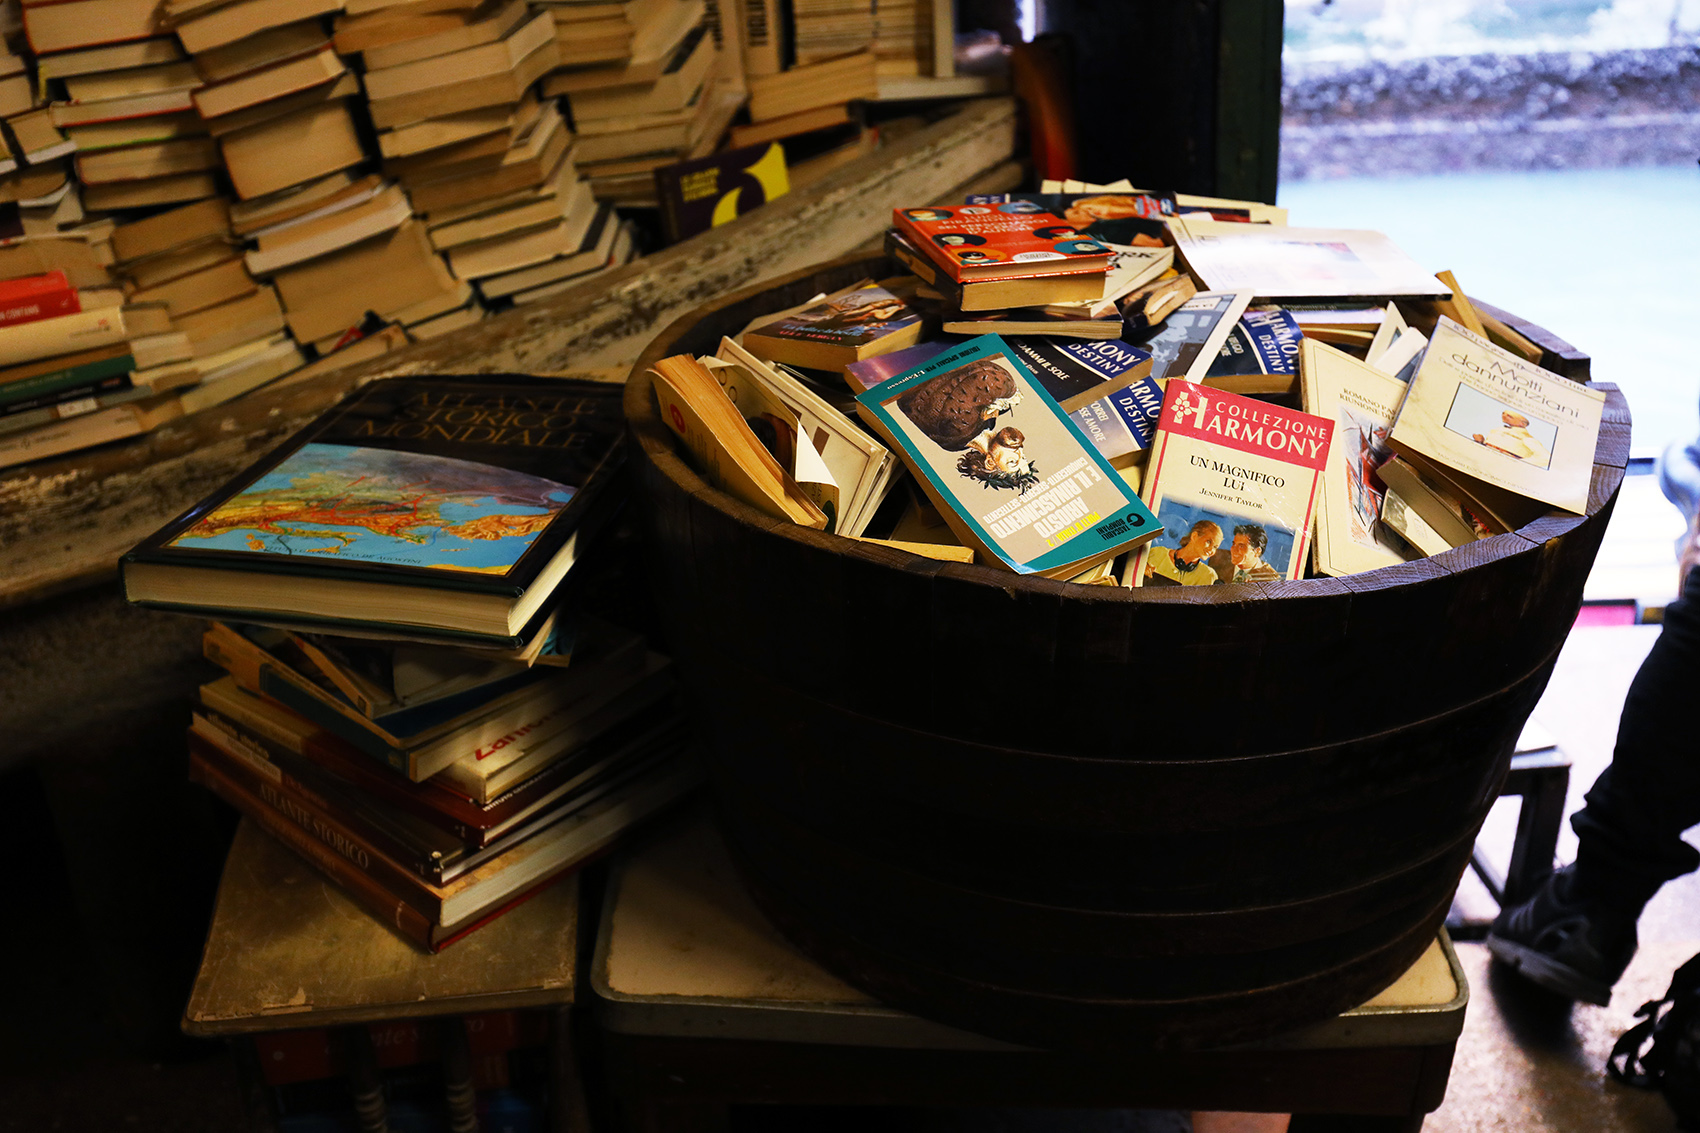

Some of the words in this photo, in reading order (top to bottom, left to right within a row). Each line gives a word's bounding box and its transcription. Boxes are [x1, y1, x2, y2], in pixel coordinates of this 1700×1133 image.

[1087, 337, 1143, 367] MONY
[1249, 310, 1300, 371] HARMO
[1258, 334, 1286, 374] DESTINY
[1048, 364, 1071, 382] SOLE
[1067, 343, 1125, 375] DESTINY
[886, 369, 926, 390] L'Espresso
[1452, 350, 1580, 419] dannunziani
[1490, 361, 1543, 394] Motti
[402, 391, 602, 415] ATLANTE
[1090, 401, 1110, 422] ORREI
[1128, 378, 1161, 420] ARMO
[1338, 392, 1381, 416] RIUNIONE
[1342, 387, 1381, 409] ROMANO
[394, 406, 578, 431] STORICO
[1085, 415, 1107, 443] AMORE
[1170, 390, 1325, 461] HARMONY
[1215, 400, 1327, 440] COLLEZIONE
[352, 419, 594, 449] MONDIALE
[1074, 470, 1095, 489] IL
[1086, 465, 1103, 483] E
[1189, 454, 1210, 469] UN
[1211, 460, 1286, 489] MAGNIFICO
[1223, 477, 1246, 492] LUI
[989, 477, 1083, 540] RINASCIMENTO
[1032, 496, 1090, 539] ARIOSTO
[1083, 511, 1101, 528] POETI
[1095, 517, 1125, 536] BOMPIANI
[1101, 523, 1132, 542] TASCABILI
[258, 783, 312, 832] ATLANTE
[313, 818, 370, 871] STORICO
